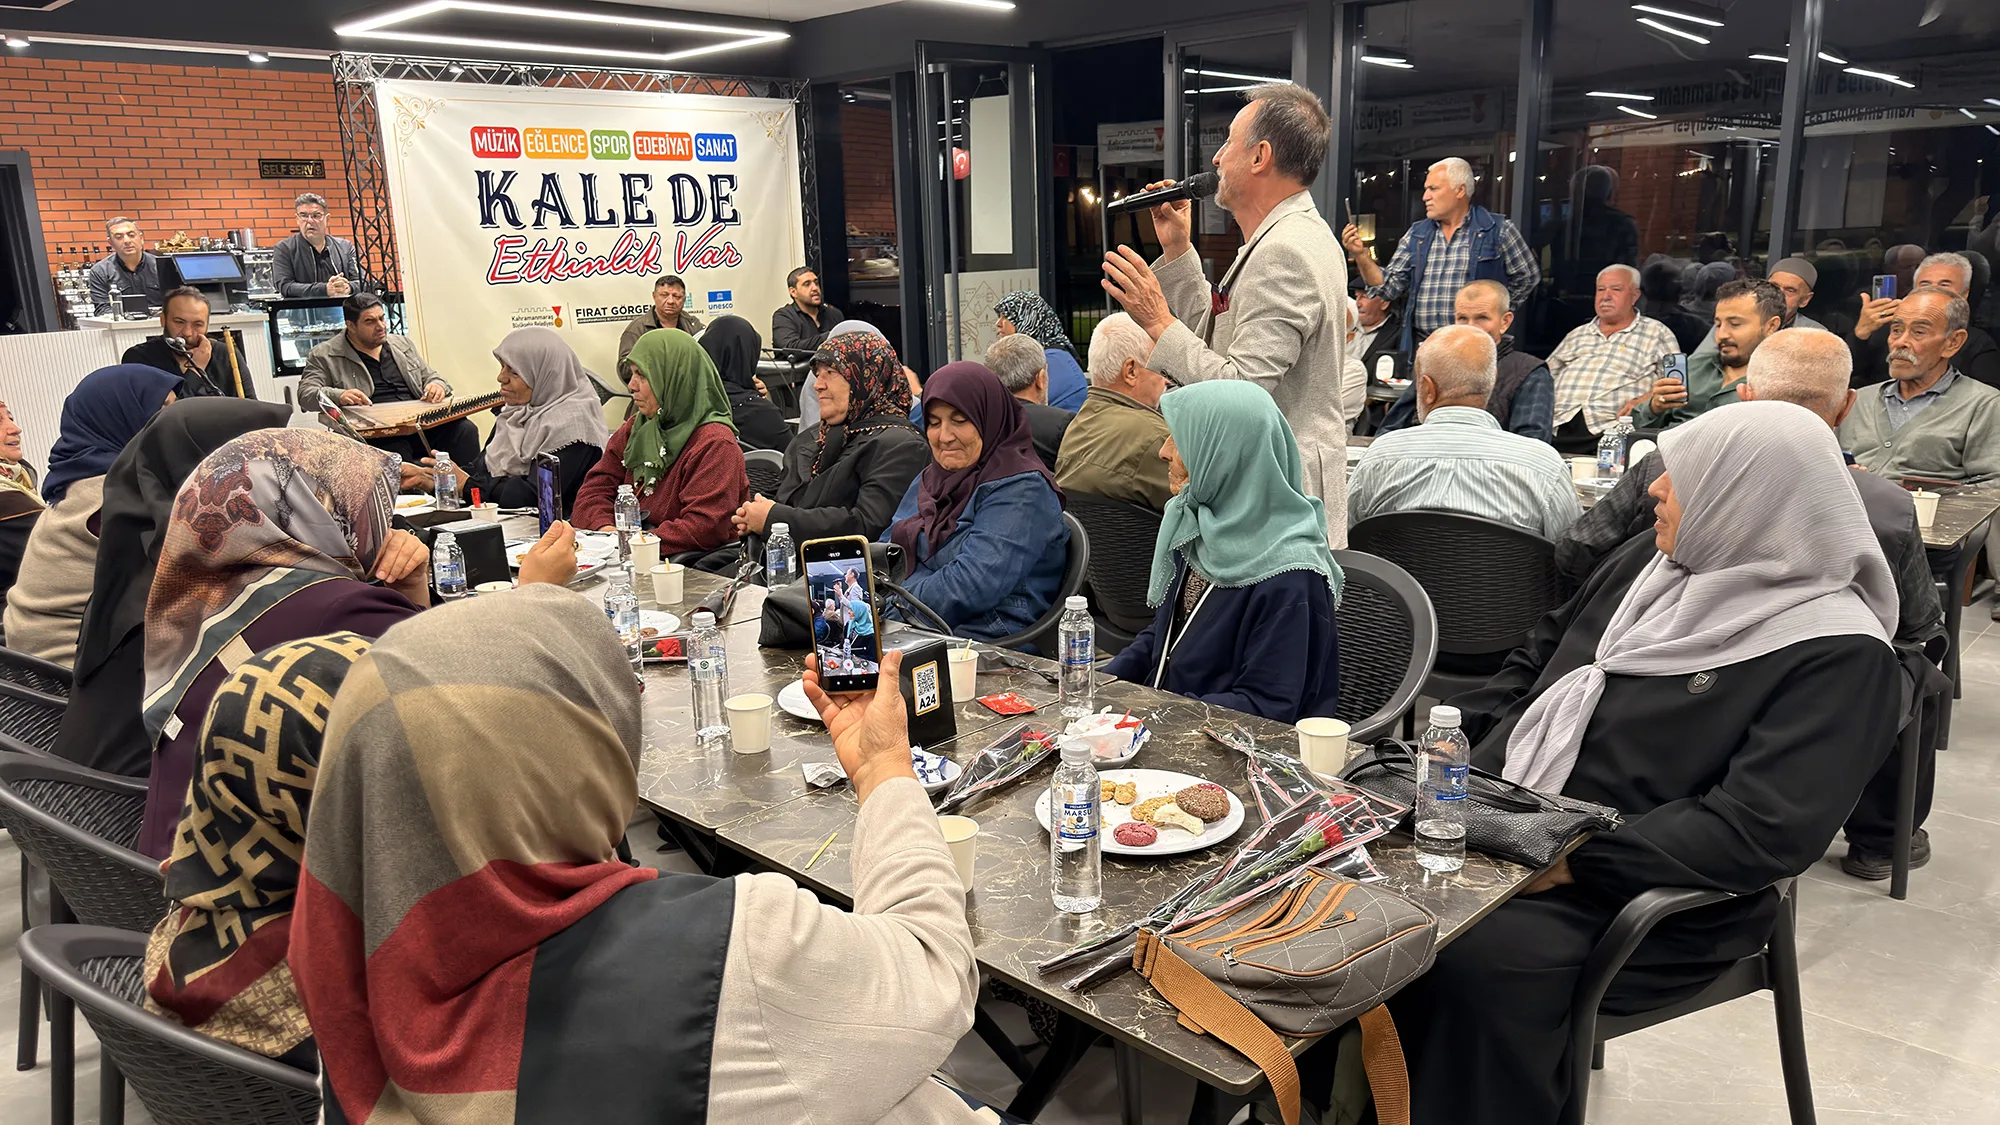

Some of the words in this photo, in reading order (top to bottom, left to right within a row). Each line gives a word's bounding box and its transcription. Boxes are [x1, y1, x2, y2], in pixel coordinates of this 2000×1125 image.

[474, 129, 519, 153] MÜZİK
[526, 129, 586, 155] EĞLENCE
[593, 135, 629, 156] SPOR
[636, 134, 690, 156] EDEBİYAT
[696, 138, 735, 157] SANAT
[263, 164, 287, 175] SELF
[474, 170, 657, 229] KALE
[667, 173, 741, 226] DE
[487, 228, 661, 285] Etkinlik
[674, 222, 742, 274] Var
[575, 306, 608, 318] FIRAT
[611, 303, 652, 315] GÖRGE
[708, 302, 733, 310] unesco
[919, 693, 936, 710] A24
[1064, 809, 1092, 817] MARSU
